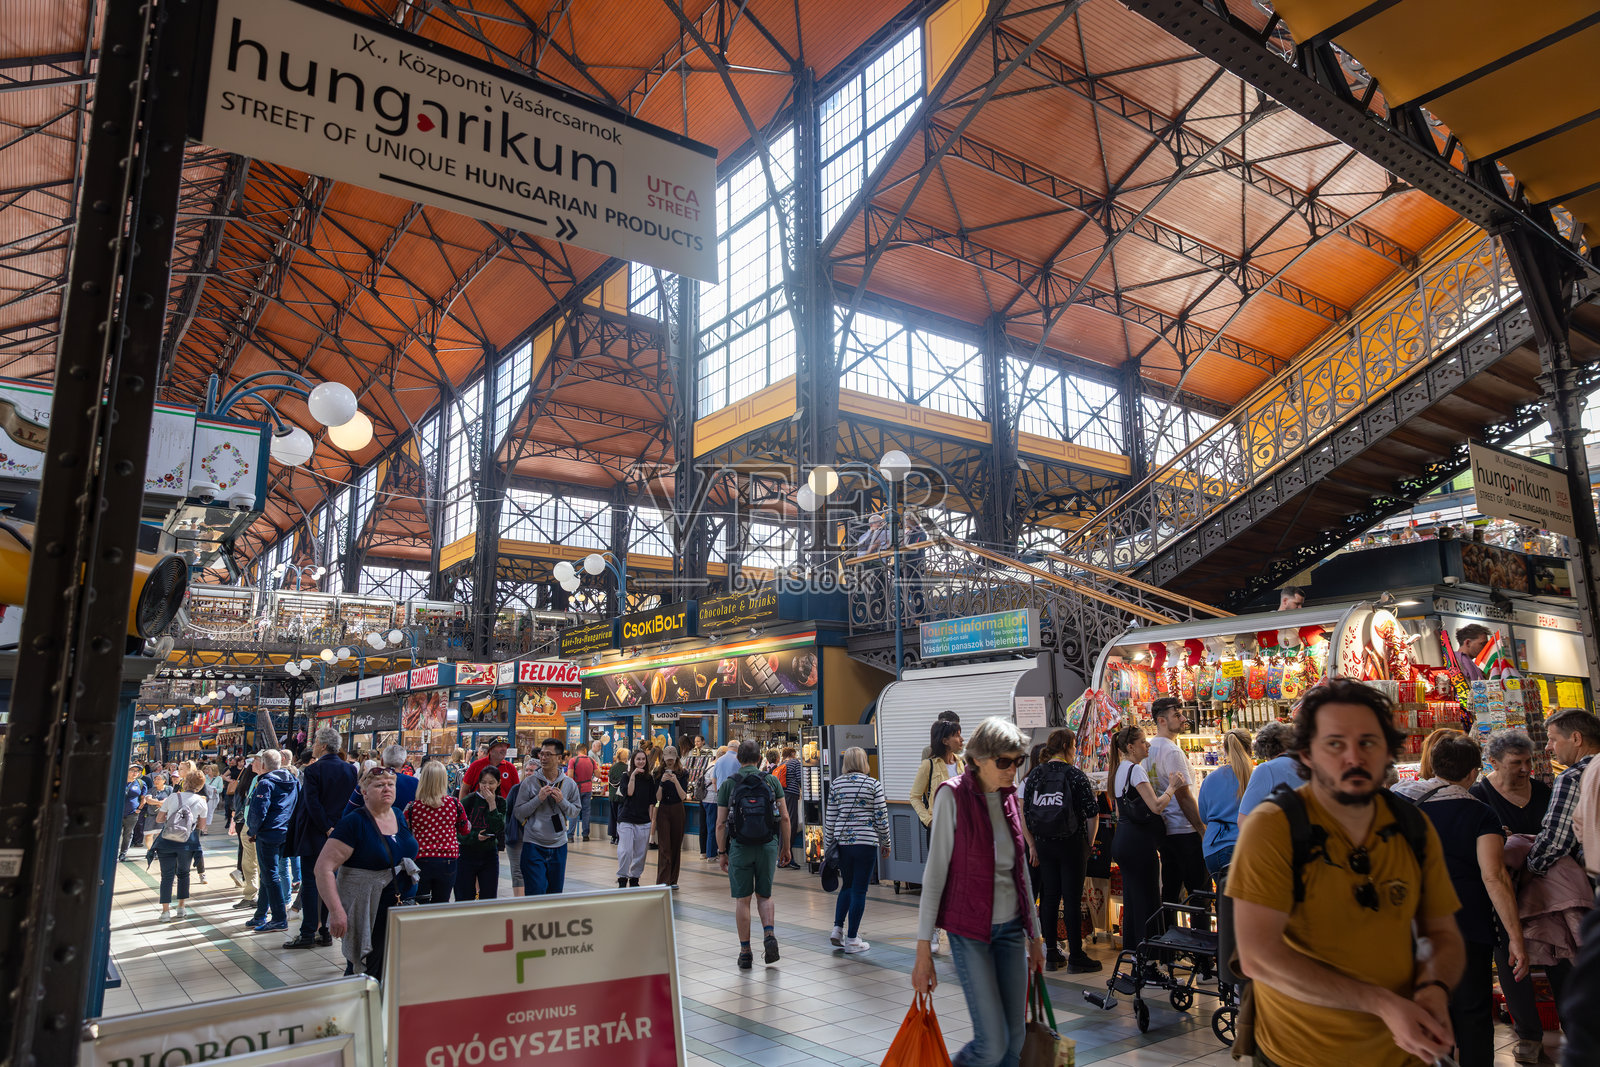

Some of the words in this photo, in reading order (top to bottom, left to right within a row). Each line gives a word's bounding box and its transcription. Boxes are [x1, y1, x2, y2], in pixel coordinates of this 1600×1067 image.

[352, 33, 389, 65] IX.,
[399, 49, 493, 98] Központi
[500, 85, 624, 145] Vásárcsarnok
[227, 17, 619, 195] hungarikum
[220, 90, 315, 134] STREET
[323, 121, 358, 147] OF
[365, 133, 457, 177] UNIQUE
[464, 164, 598, 220] HUNGARIAN
[604, 207, 704, 252] PRODUCTS
[646, 174, 701, 208] UTCA
[646, 193, 702, 223] STREET
[1476, 459, 1551, 503] hungarikum
[699, 604, 737, 620] Chocolate
[740, 600, 745, 611] &
[749, 594, 776, 609] Drinks
[922, 623, 958, 638] Tourist
[961, 613, 1027, 633] information
[951, 640, 984, 652] panaszok
[985, 635, 1028, 648] bejelentése
[1033, 791, 1063, 806] VANS
[522, 918, 593, 942] KULCS
[551, 942, 594, 956] PATIKÁK
[506, 1004, 577, 1024] CORVINUS
[426, 1012, 652, 1067] GYÓGYSZERTÁR
